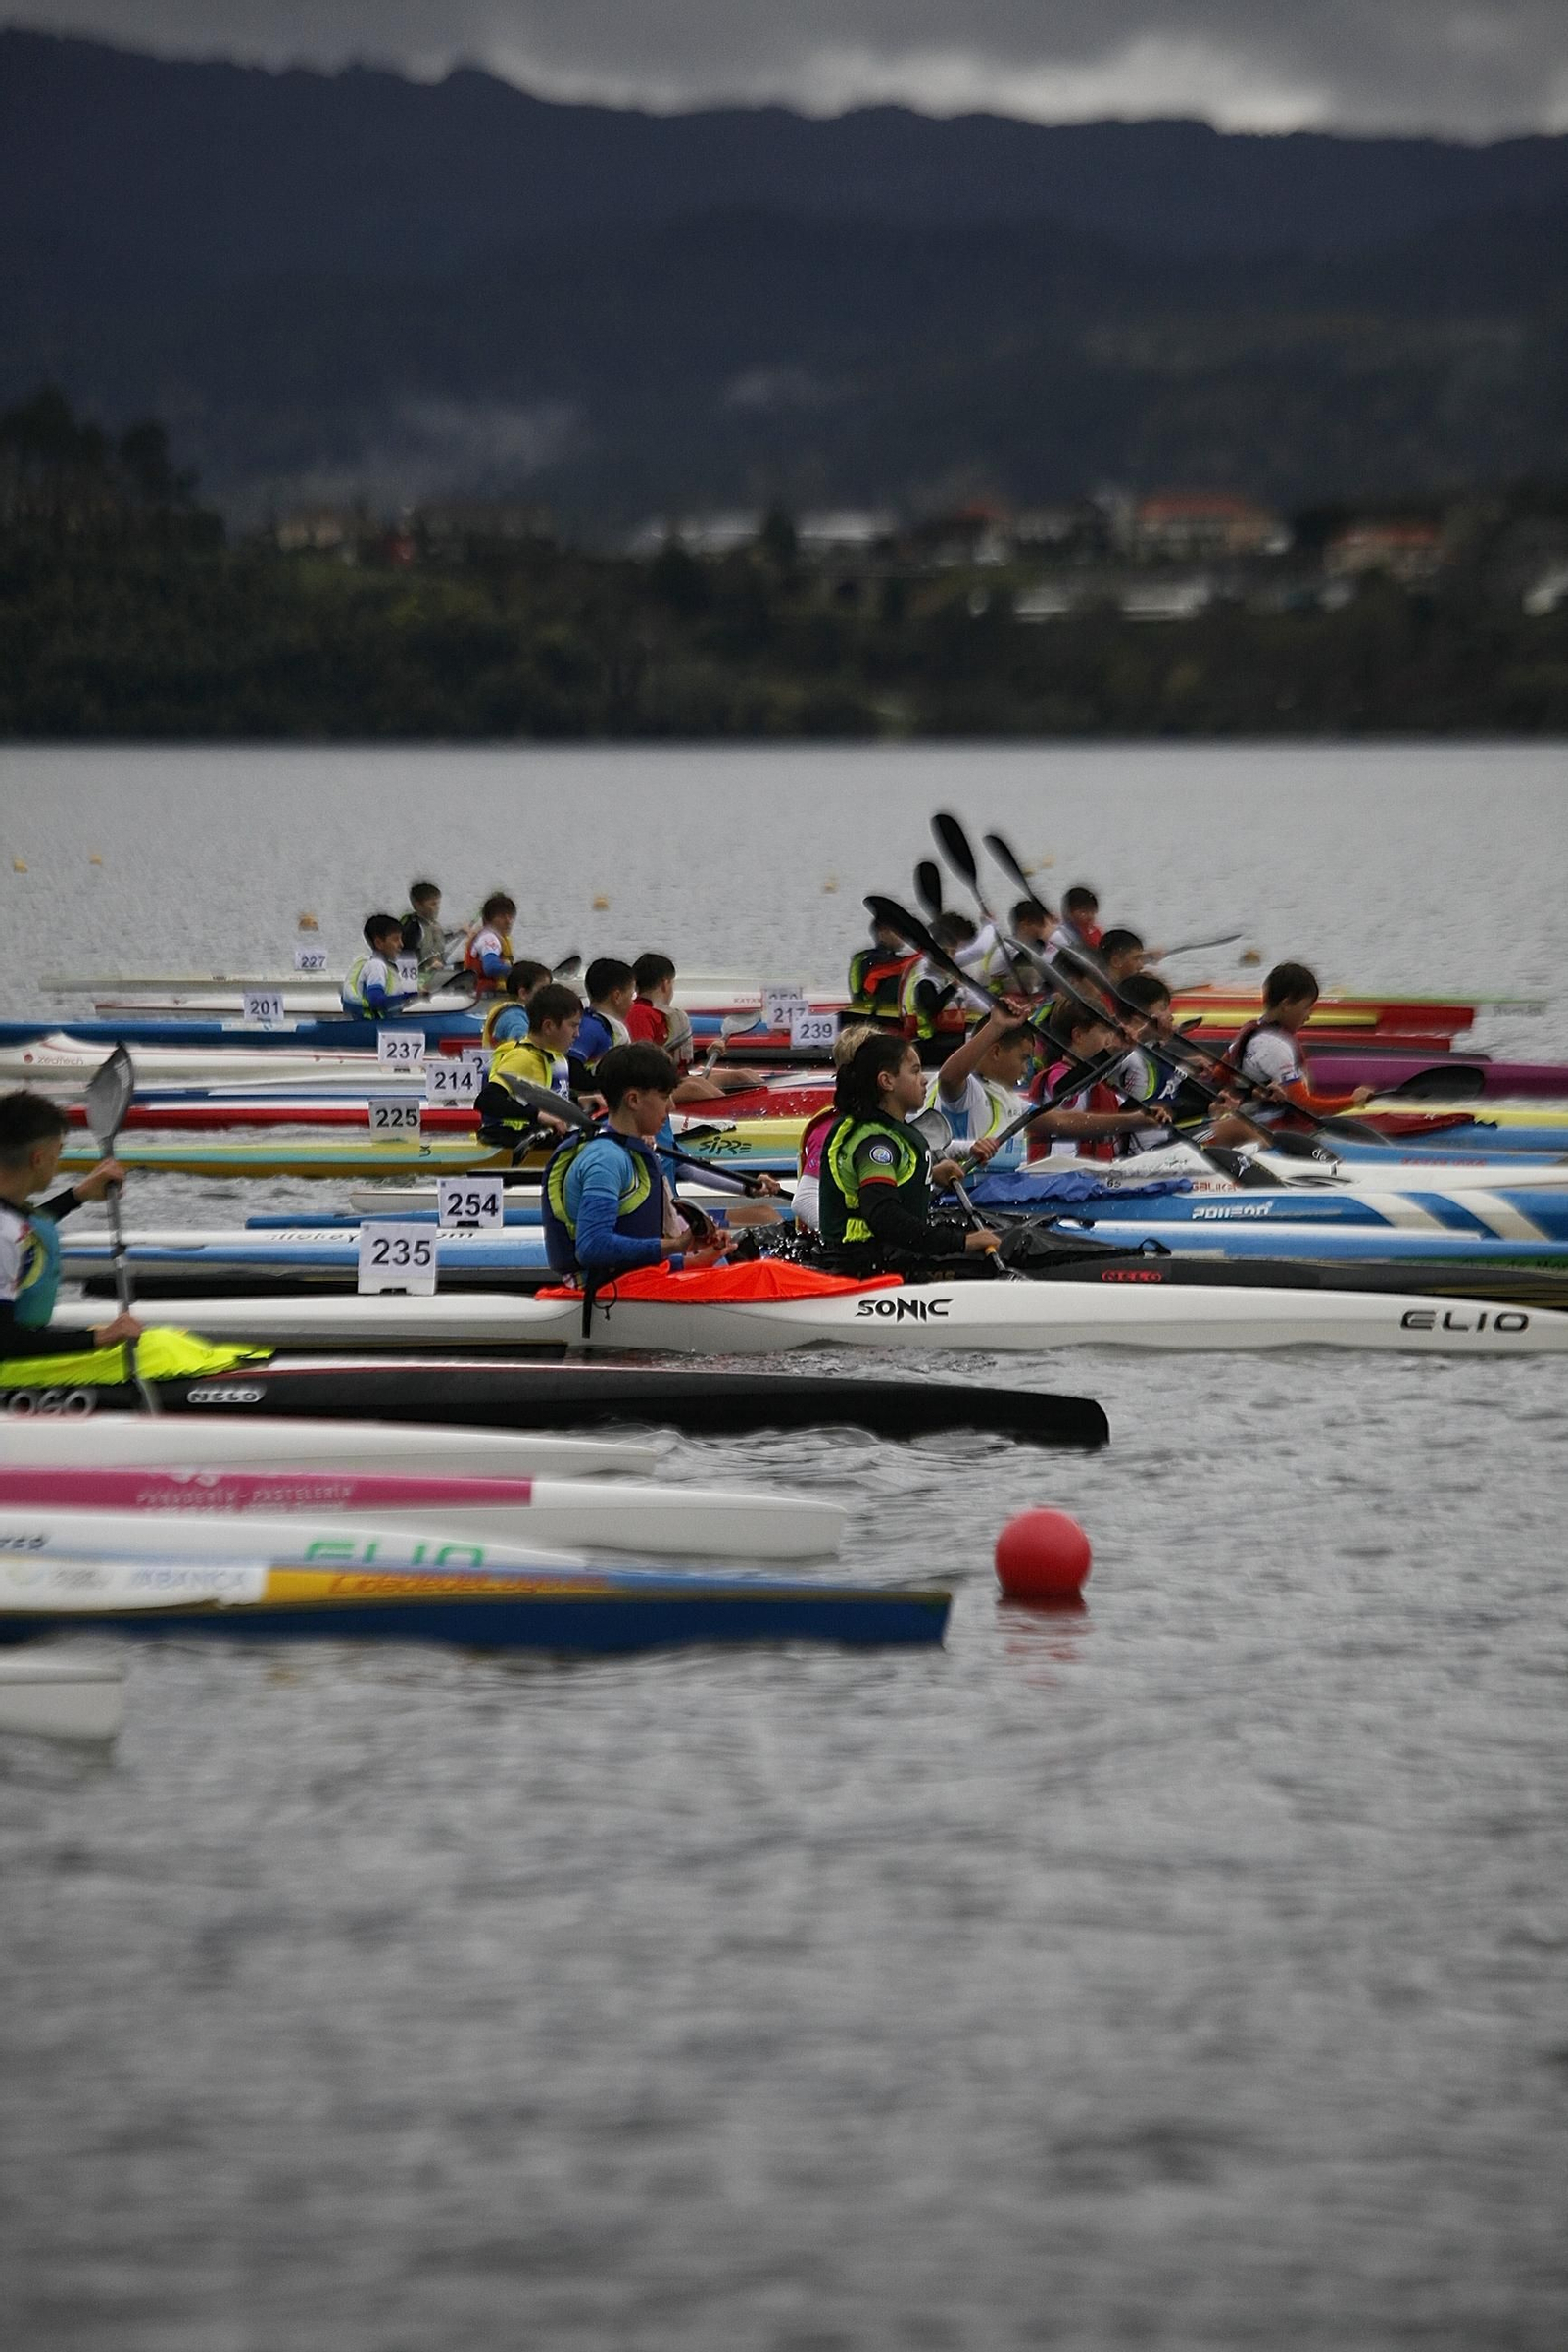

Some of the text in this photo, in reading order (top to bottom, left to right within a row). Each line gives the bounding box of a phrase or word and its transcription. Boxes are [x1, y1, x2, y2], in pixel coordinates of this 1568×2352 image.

[300, 956, 326, 968] 227
[250, 1001, 279, 1015] 201
[800, 1023, 833, 1039] 239
[386, 1042, 422, 1059] 237
[434, 1072, 473, 1090] 214
[375, 1108, 418, 1128] 225
[447, 1193, 499, 1217] 254
[371, 1238, 431, 1266] 235
[854, 1297, 954, 1323] SONIC
[1400, 1310, 1530, 1333] ELIO
[190, 1391, 260, 1402] NELO
